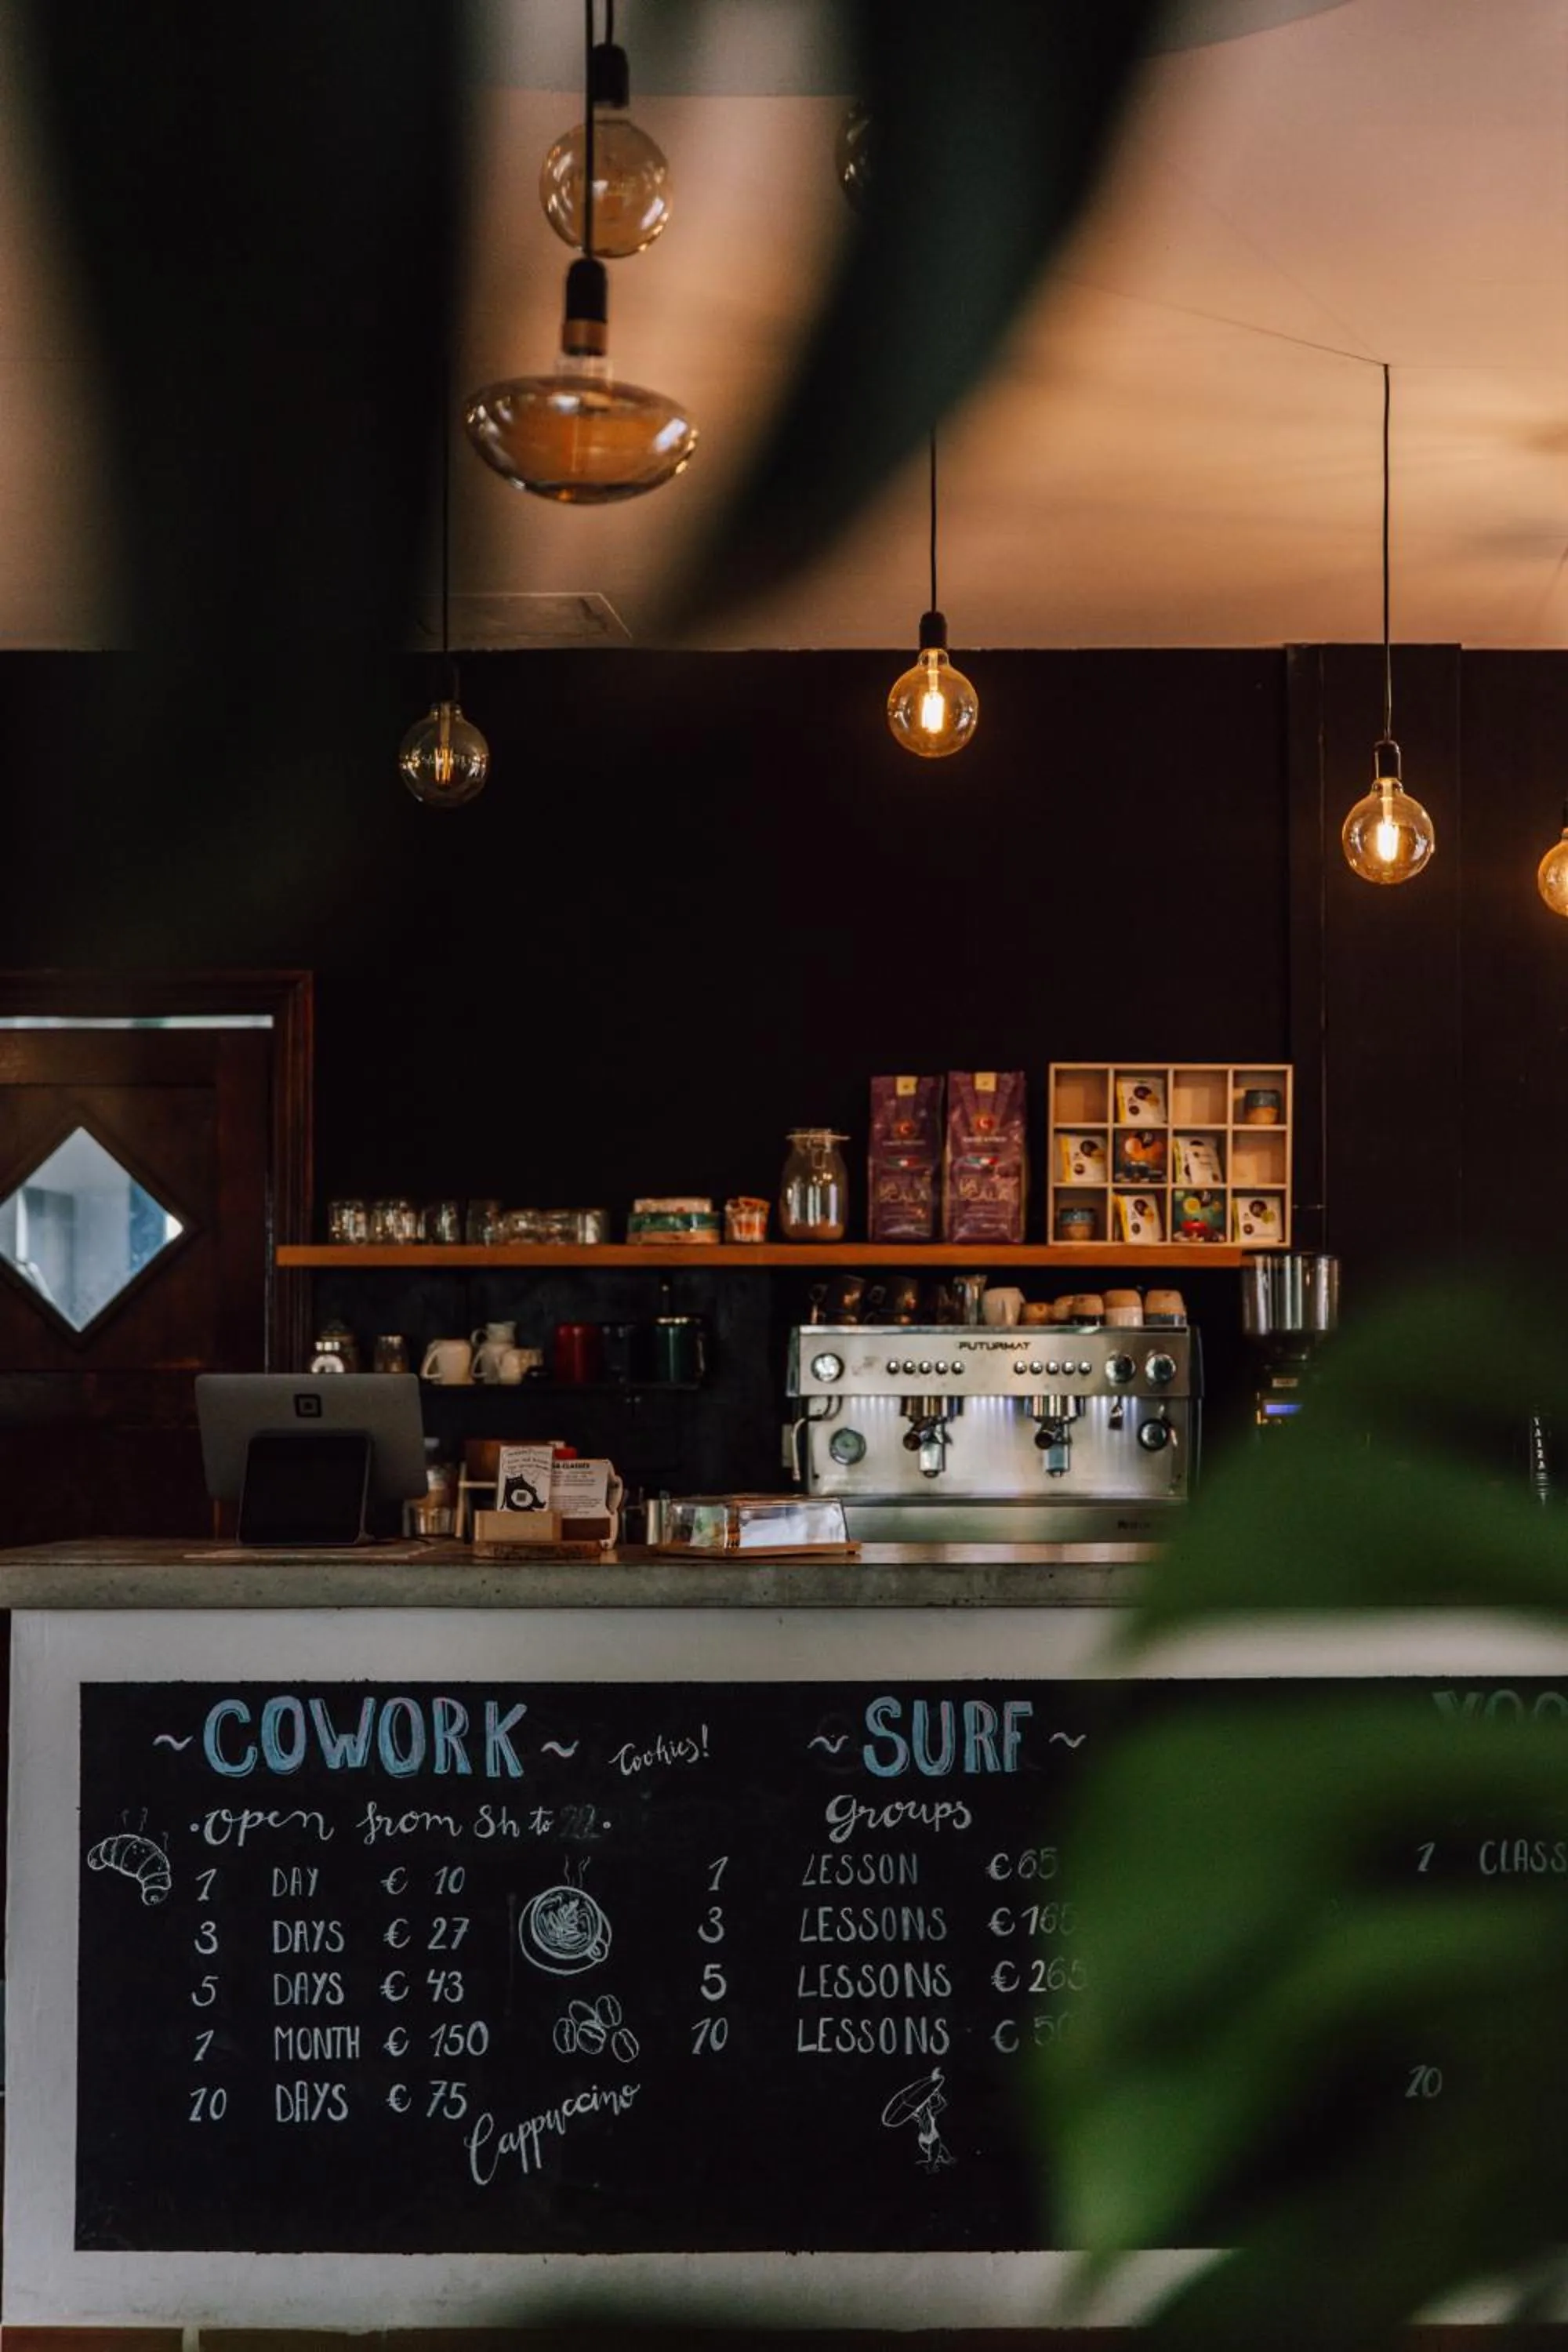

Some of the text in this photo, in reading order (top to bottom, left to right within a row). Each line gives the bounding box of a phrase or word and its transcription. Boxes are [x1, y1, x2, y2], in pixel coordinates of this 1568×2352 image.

[202, 1696, 527, 1777] COWORK
[608, 1724, 710, 1776] Cookies!
[863, 1697, 1033, 1777] SURF
[355, 1801, 463, 1845] from
[528, 1806, 554, 1836] to
[709, 1856, 728, 1891] 1
[801, 1853, 917, 1886] LESSON
[1416, 1838, 1568, 1875] 1 CLASS
[195, 1868, 217, 1902] 1
[272, 1867, 319, 1897] DAY
[435, 1866, 465, 1895] 10
[194, 1920, 219, 1955] 3
[272, 1919, 345, 1954] DAYS
[427, 1916, 470, 1950] 27
[698, 1906, 724, 1944] 3
[799, 1906, 947, 1943] LESSONS
[191, 1975, 219, 2007] 5
[273, 1971, 345, 2006] DAYS
[426, 1969, 464, 2003] 43
[700, 1963, 727, 2002] 5
[797, 1962, 952, 1999] LESSONS
[194, 2029, 214, 2062] 1
[274, 2025, 361, 2061] MONTH
[429, 2020, 489, 2057] 150
[691, 2017, 728, 2055] 10
[797, 2016, 950, 2056] LESSONS
[189, 2087, 227, 2122] 10
[275, 2080, 349, 2123] DAYS
[426, 2080, 467, 2120] 75
